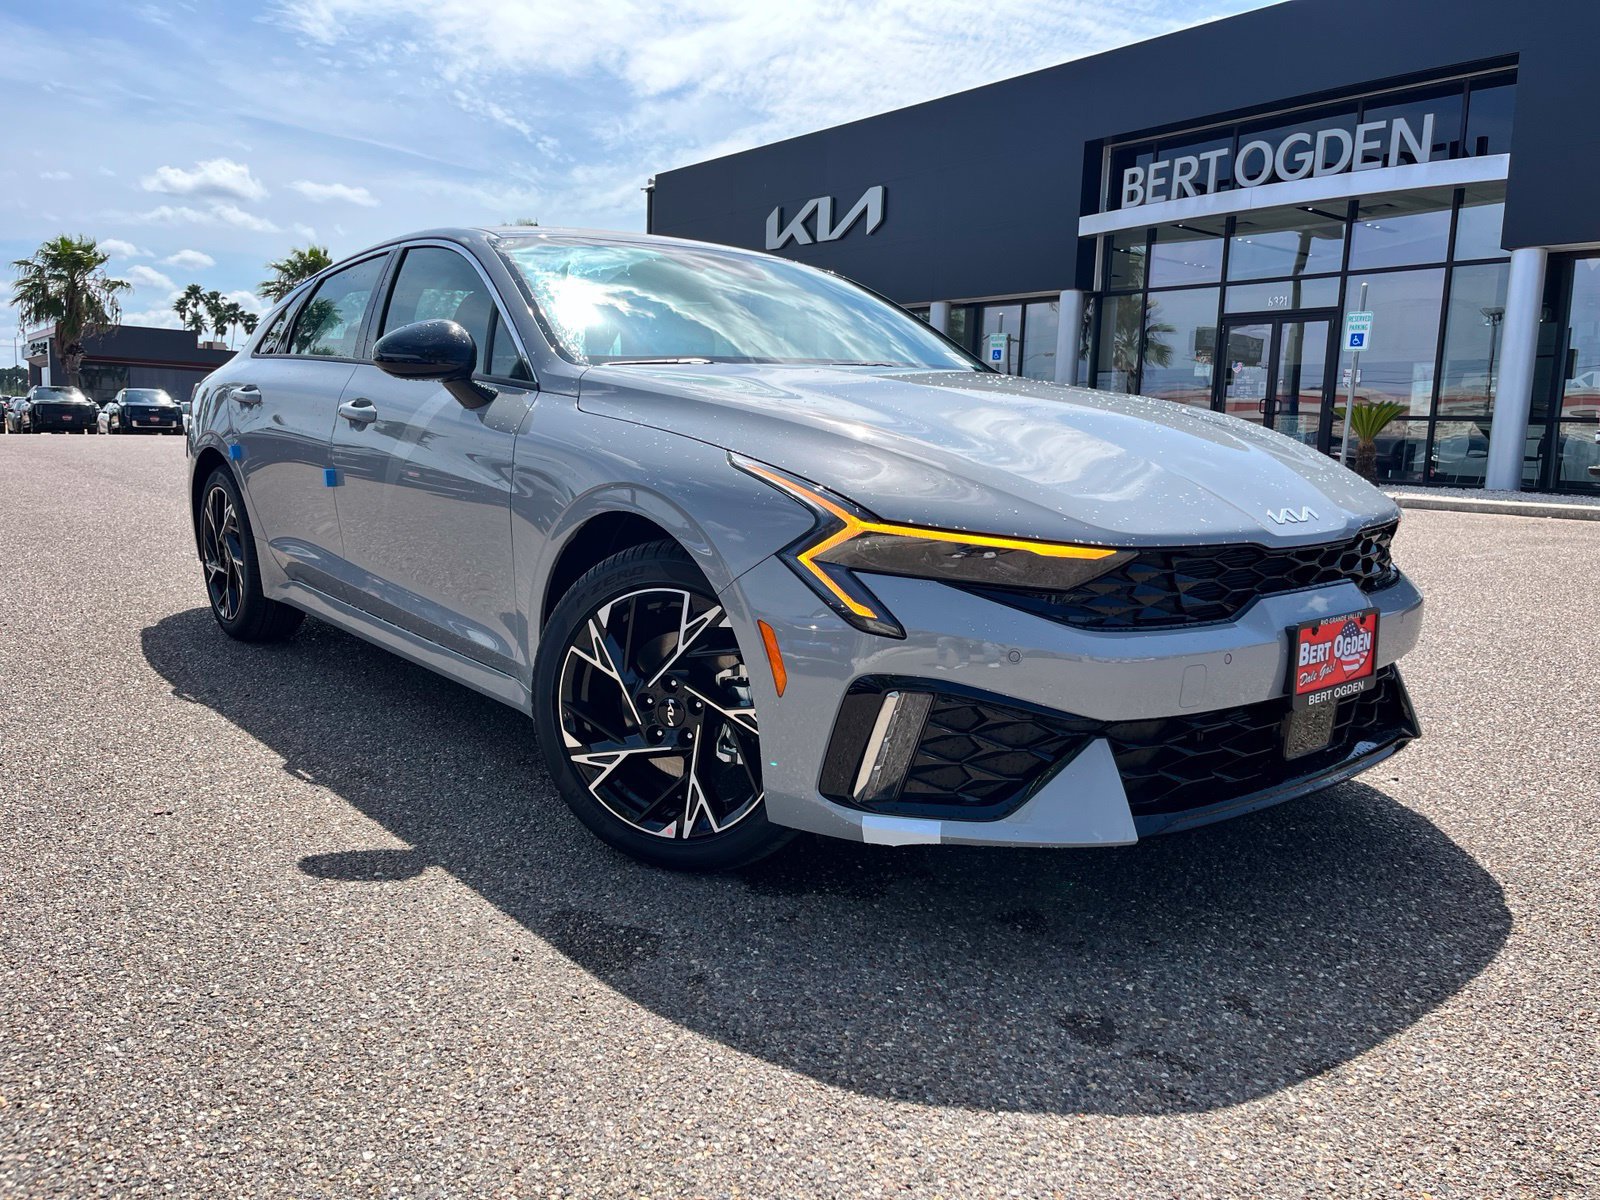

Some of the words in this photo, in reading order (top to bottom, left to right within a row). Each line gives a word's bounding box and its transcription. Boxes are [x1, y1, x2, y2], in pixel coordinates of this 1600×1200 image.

[1121, 148, 1229, 208] BERT
[1234, 113, 1434, 188] OGDEN
[765, 185, 884, 250] KIA
[1267, 505, 1319, 525] KIA
[1329, 615, 1347, 624] GRANDE
[1347, 611, 1363, 620] VALLEY
[1299, 642, 1332, 667] BERT
[1334, 631, 1371, 658] OGDEN
[1308, 690, 1332, 705] BERT
[1334, 680, 1365, 698] OGDEN
